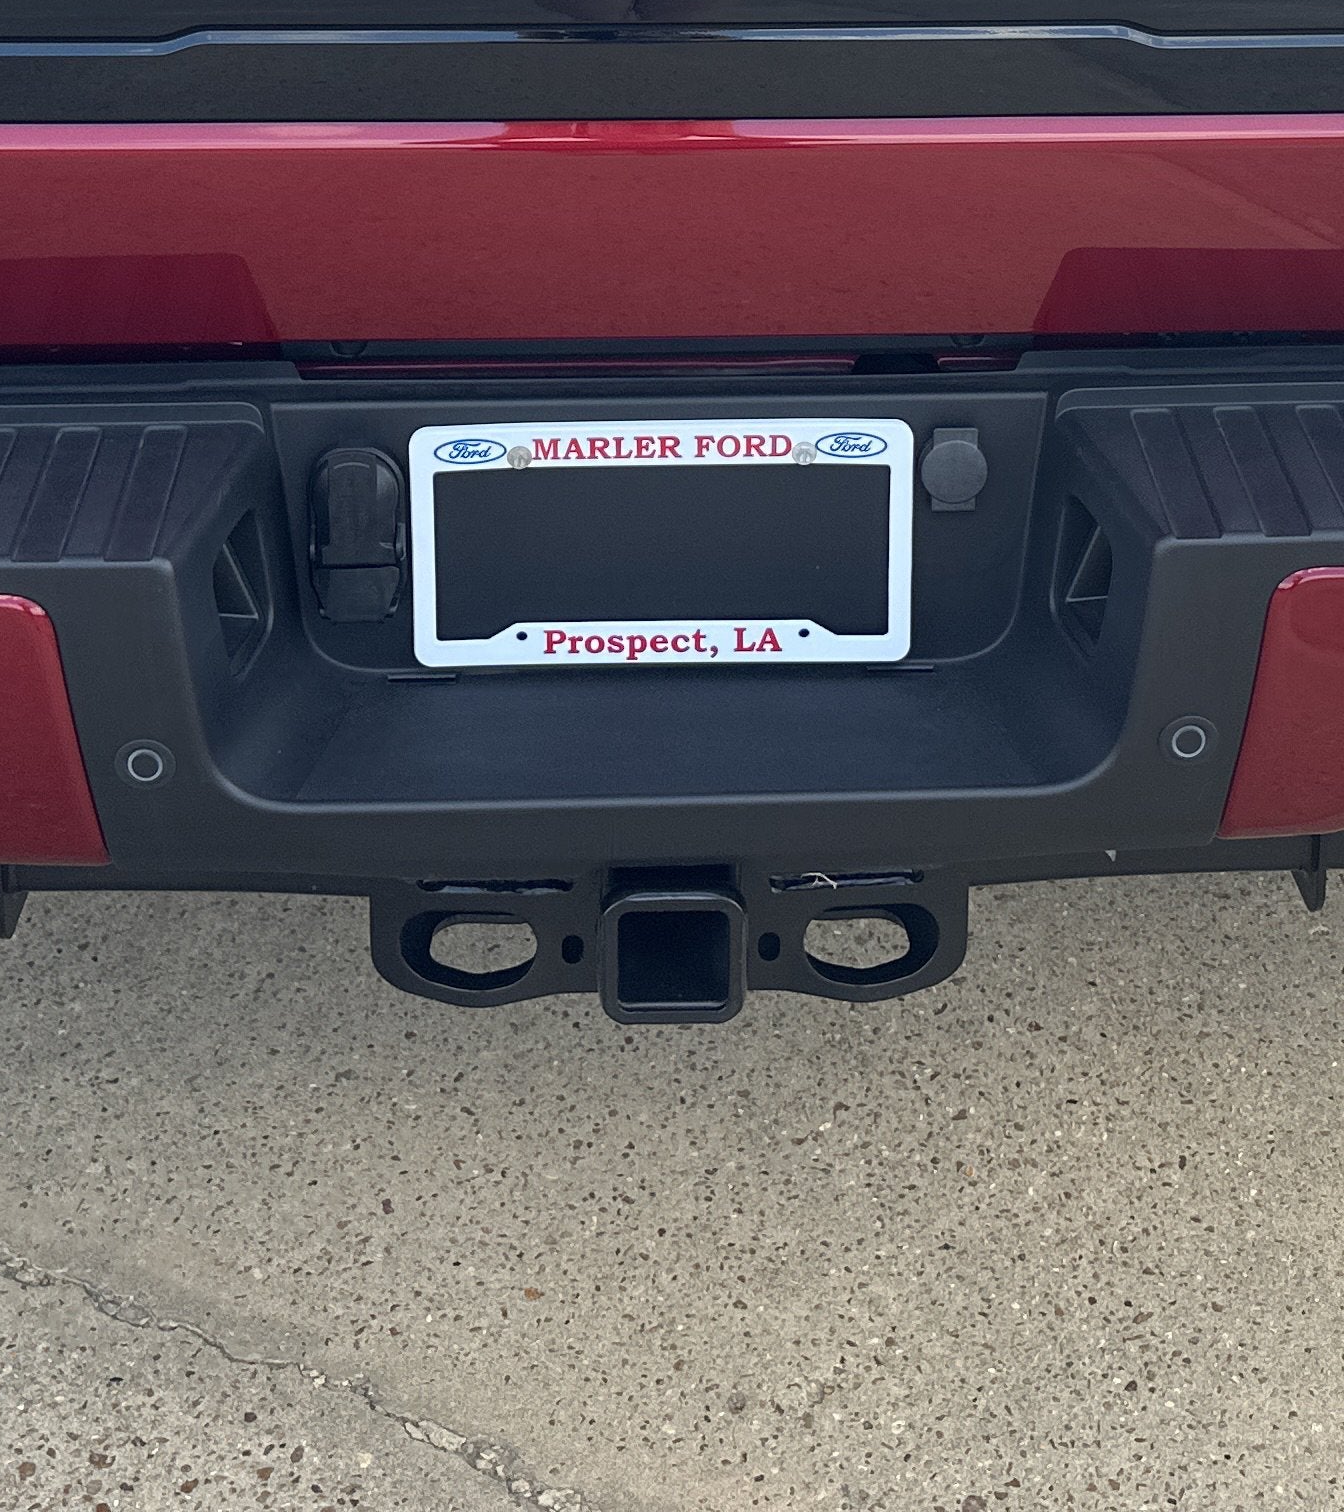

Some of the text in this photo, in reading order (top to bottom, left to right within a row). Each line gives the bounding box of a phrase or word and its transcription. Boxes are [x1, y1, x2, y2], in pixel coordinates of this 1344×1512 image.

[447, 440, 492, 459] Ford
[531, 433, 793, 461] MARLER FORD
[828, 435, 872, 455] Ford
[543, 626, 784, 661] Prospect, LA
